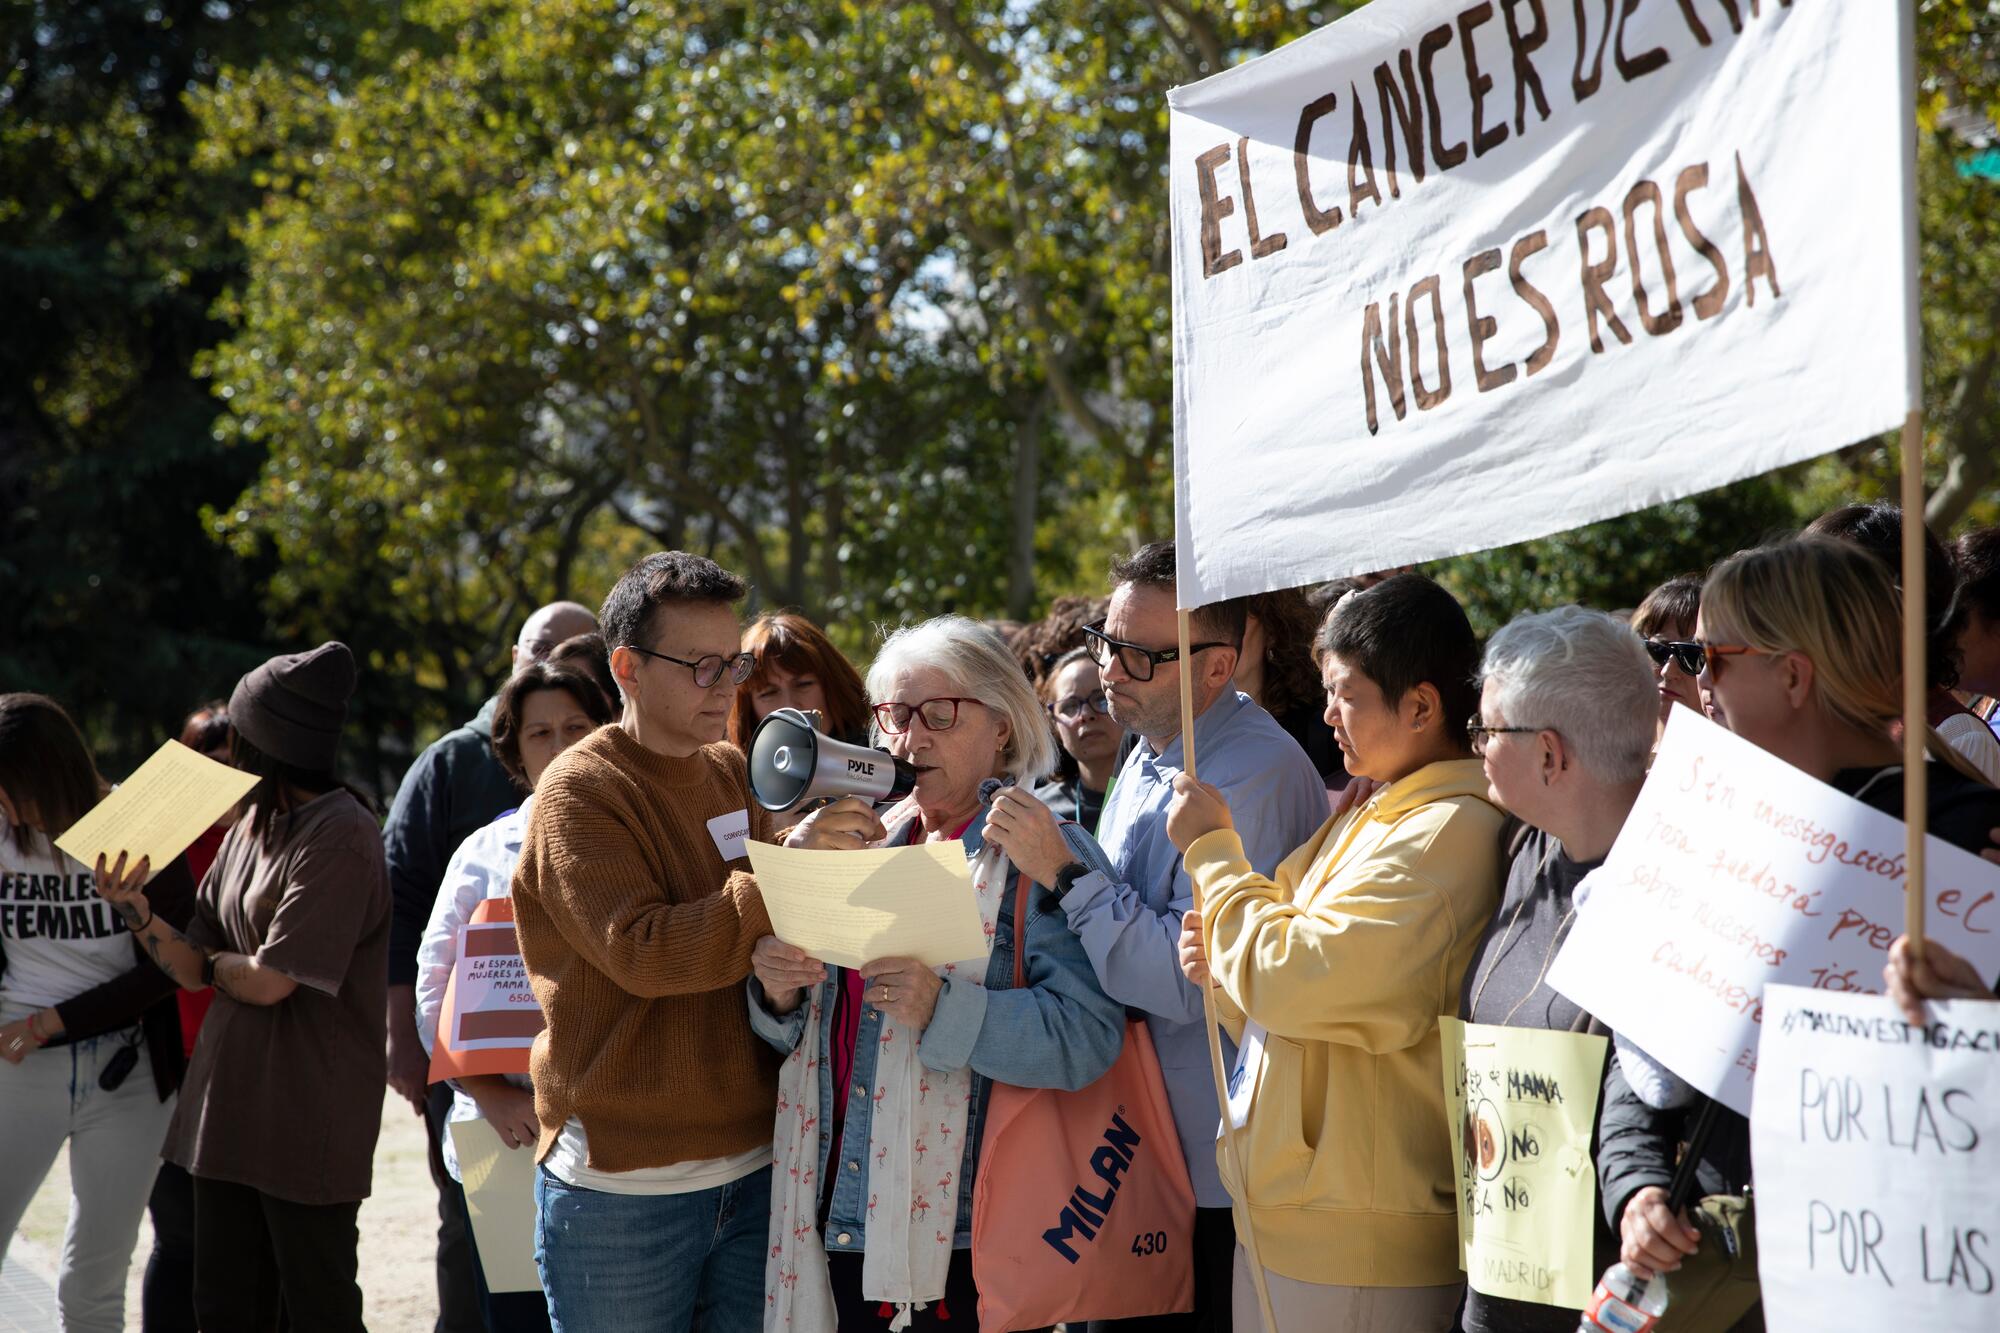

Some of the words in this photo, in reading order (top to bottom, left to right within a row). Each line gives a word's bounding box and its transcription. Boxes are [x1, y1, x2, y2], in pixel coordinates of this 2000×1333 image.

[1196, 136, 1287, 279] EL
[1295, 0, 1550, 236] CANCER
[1361, 275, 1452, 436] NO
[1464, 230, 1560, 393] ES
[1576, 150, 1782, 354] ROSA
[1800, 1067, 1869, 1143] POR
[1884, 1083, 1980, 1155] LAS
[1042, 1112, 1142, 1265] MILAN
[1131, 1231, 1168, 1257] 430
[1808, 1199, 1895, 1288] POR
[1921, 1224, 1994, 1296] LAS
